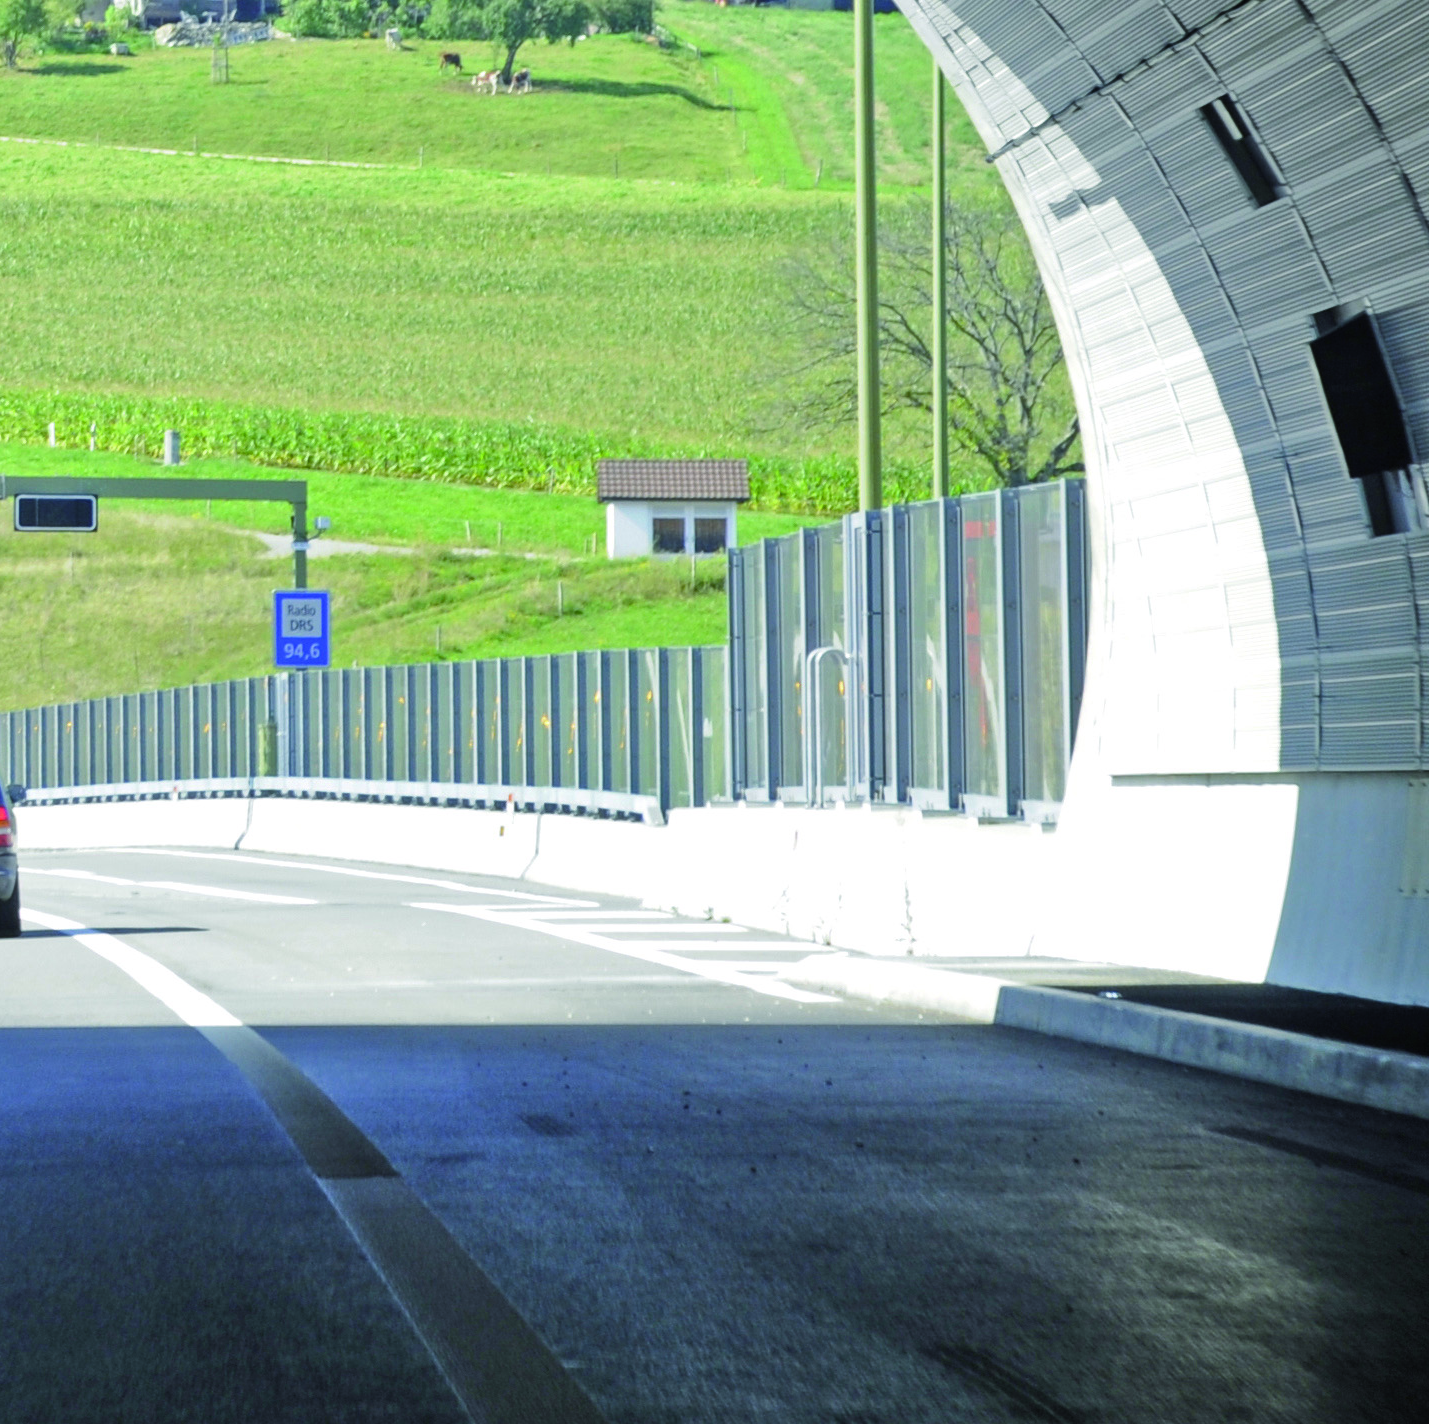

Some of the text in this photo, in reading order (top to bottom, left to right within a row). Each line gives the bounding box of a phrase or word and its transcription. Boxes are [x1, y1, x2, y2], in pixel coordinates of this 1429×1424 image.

[287, 604, 316, 617] Radio
[290, 619, 314, 632] DRS
[284, 643, 320, 660] 94,6
